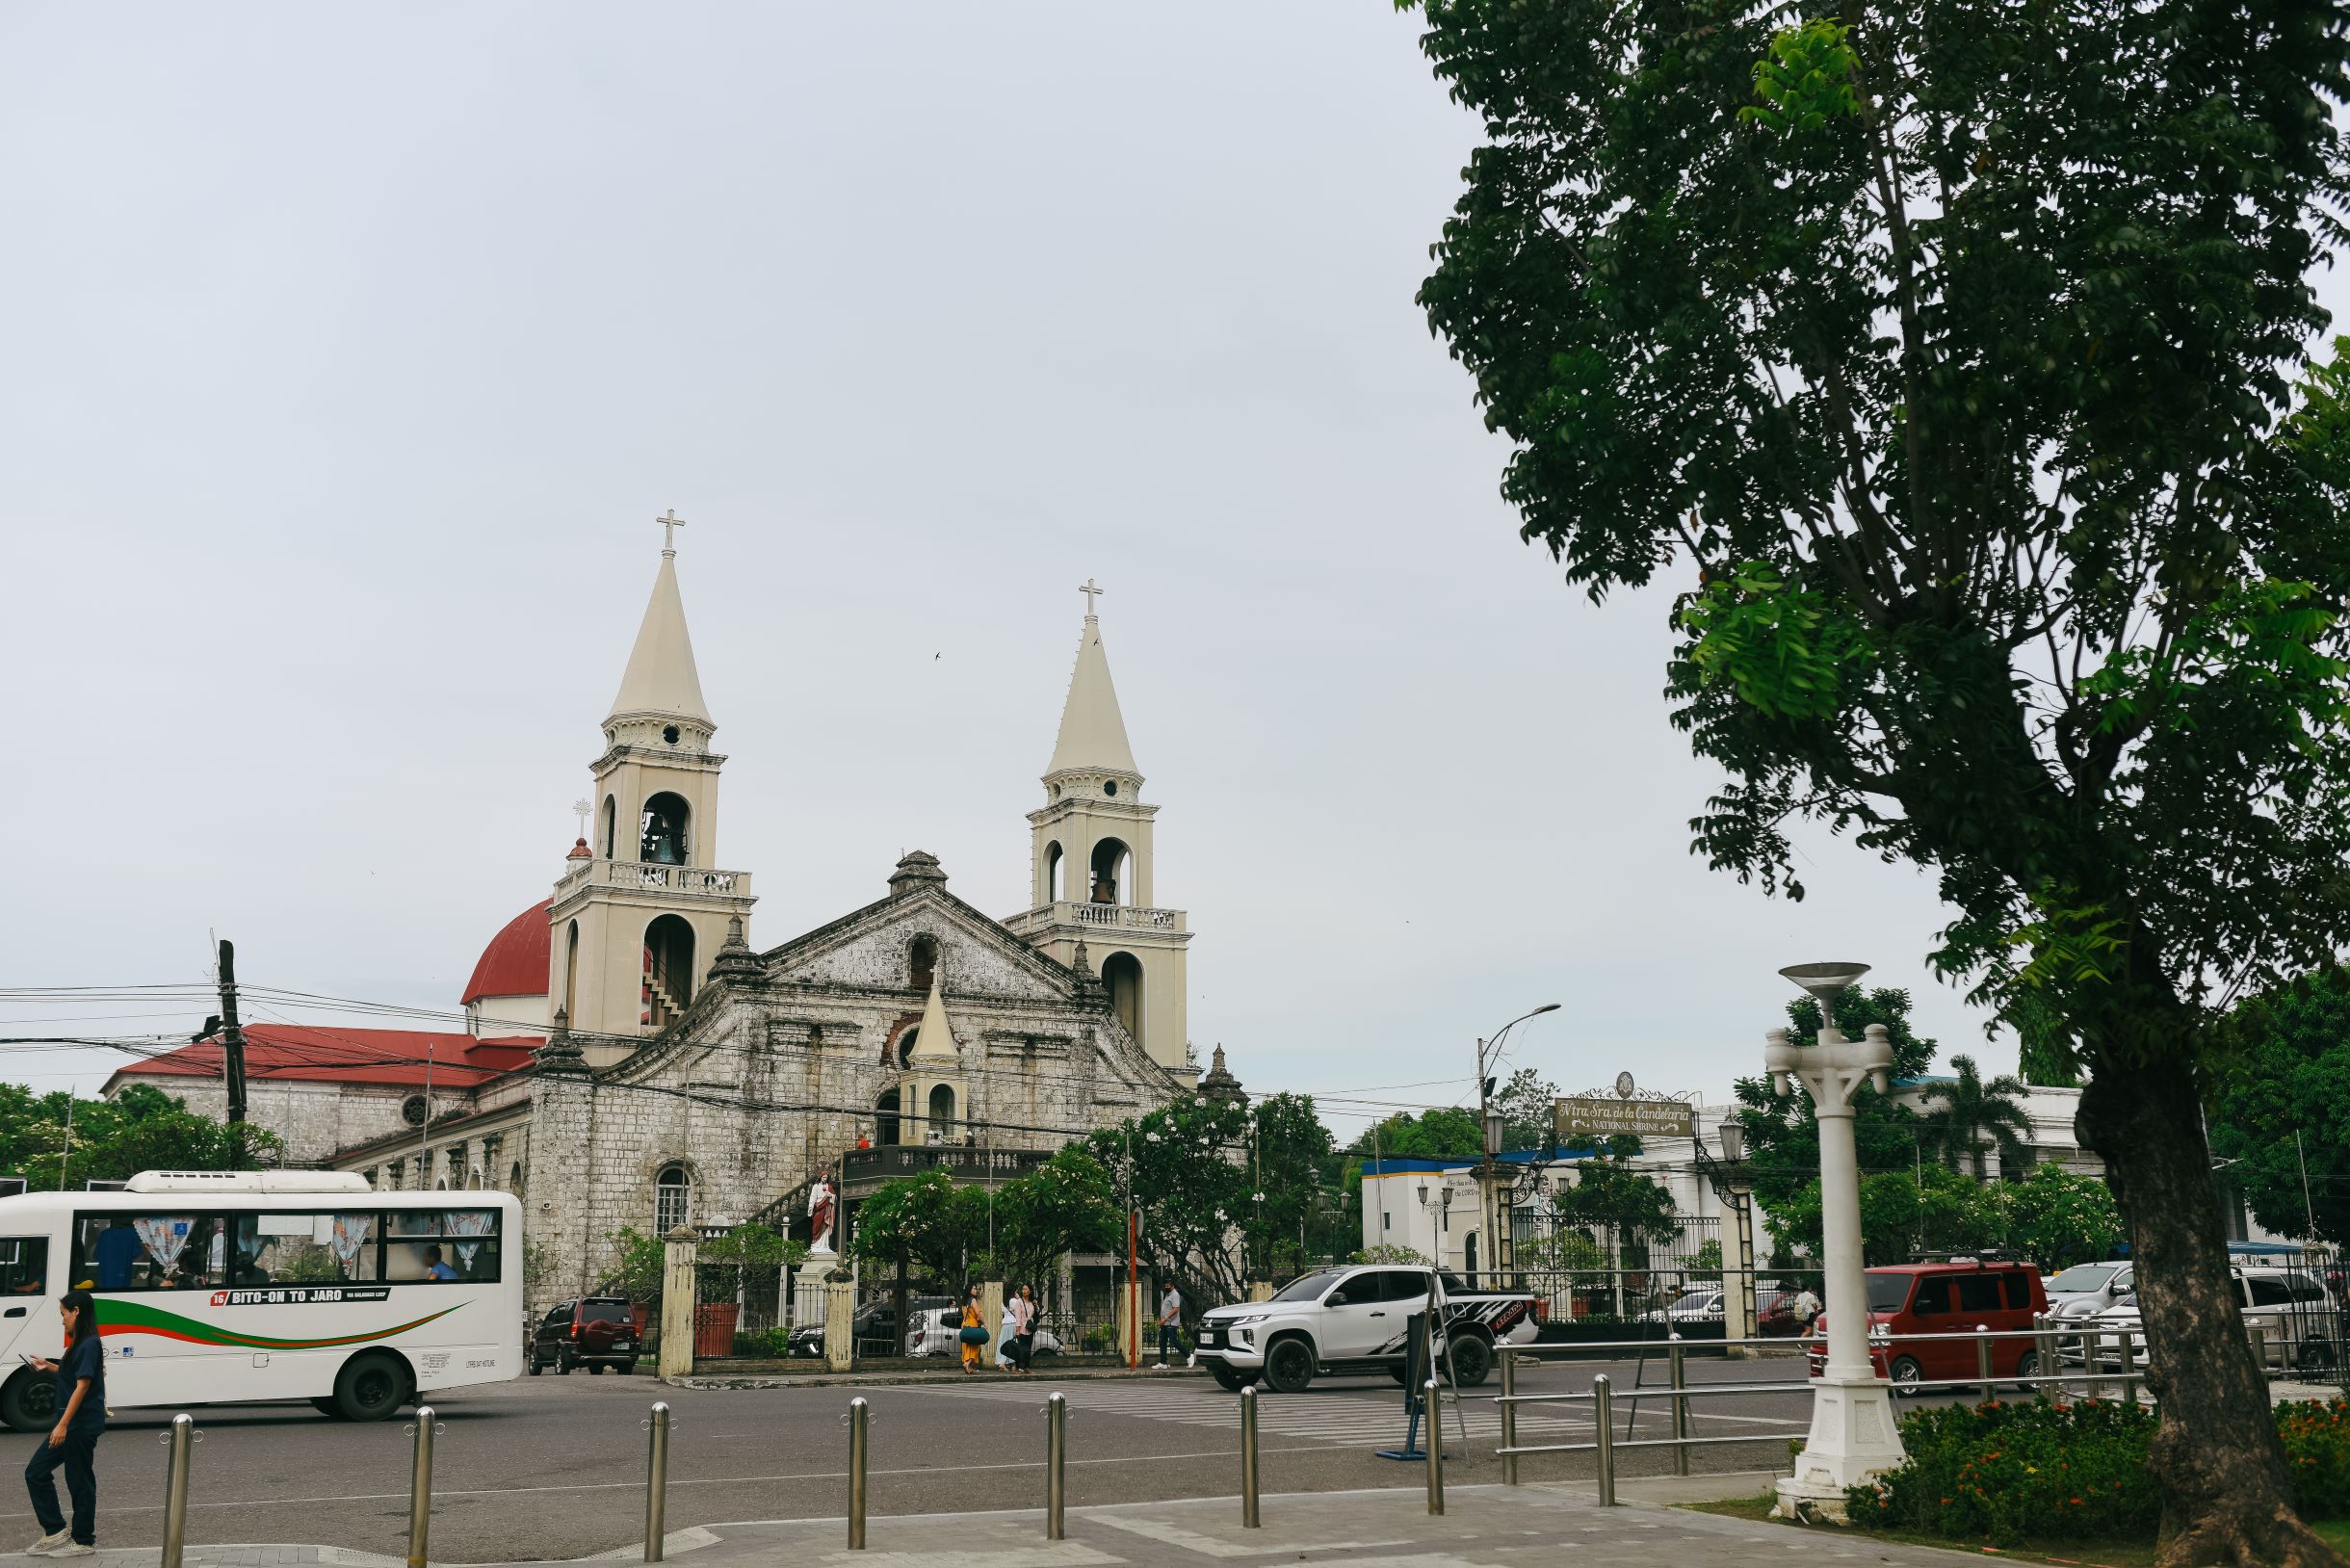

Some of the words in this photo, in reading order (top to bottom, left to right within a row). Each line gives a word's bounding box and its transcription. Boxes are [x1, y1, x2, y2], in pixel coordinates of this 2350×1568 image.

[1558, 1103, 1588, 1117] Ntra.
[1590, 1103, 1612, 1118] Sra.
[1614, 1107, 1624, 1118] de
[1625, 1106, 1634, 1118] la
[1635, 1107, 1689, 1121] Candelaria
[1592, 1120, 1630, 1131] NATIONAL
[1632, 1122, 1658, 1132] SHRINE
[214, 1294, 223, 1304] 16
[231, 1291, 285, 1304] BITO-ON
[289, 1291, 304, 1302] TO
[310, 1290, 342, 1301] JARO
